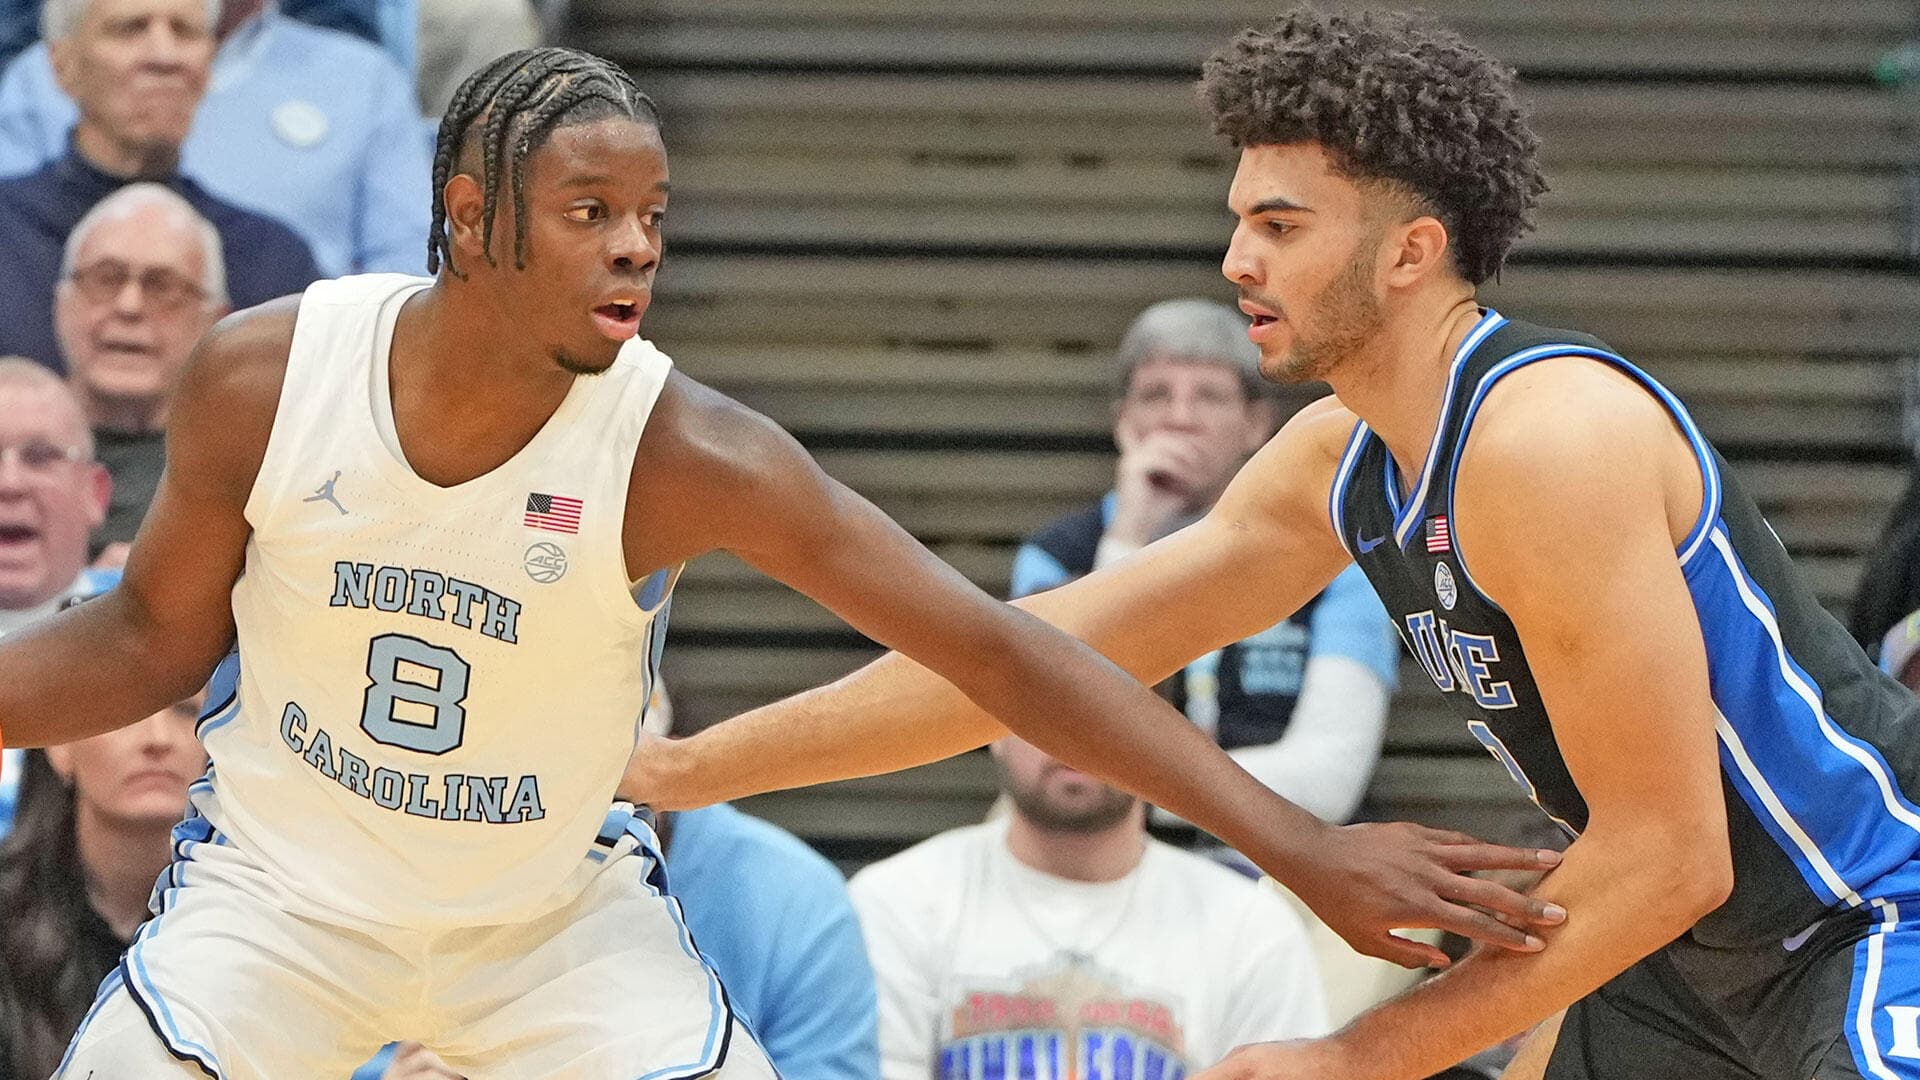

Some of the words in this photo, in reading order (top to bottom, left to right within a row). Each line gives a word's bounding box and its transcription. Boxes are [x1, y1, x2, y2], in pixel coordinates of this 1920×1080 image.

[329, 561, 522, 645] NORTH
[359, 632, 471, 756] 8
[1392, 610, 1518, 710] UE
[279, 701, 546, 824] CAROLINA
